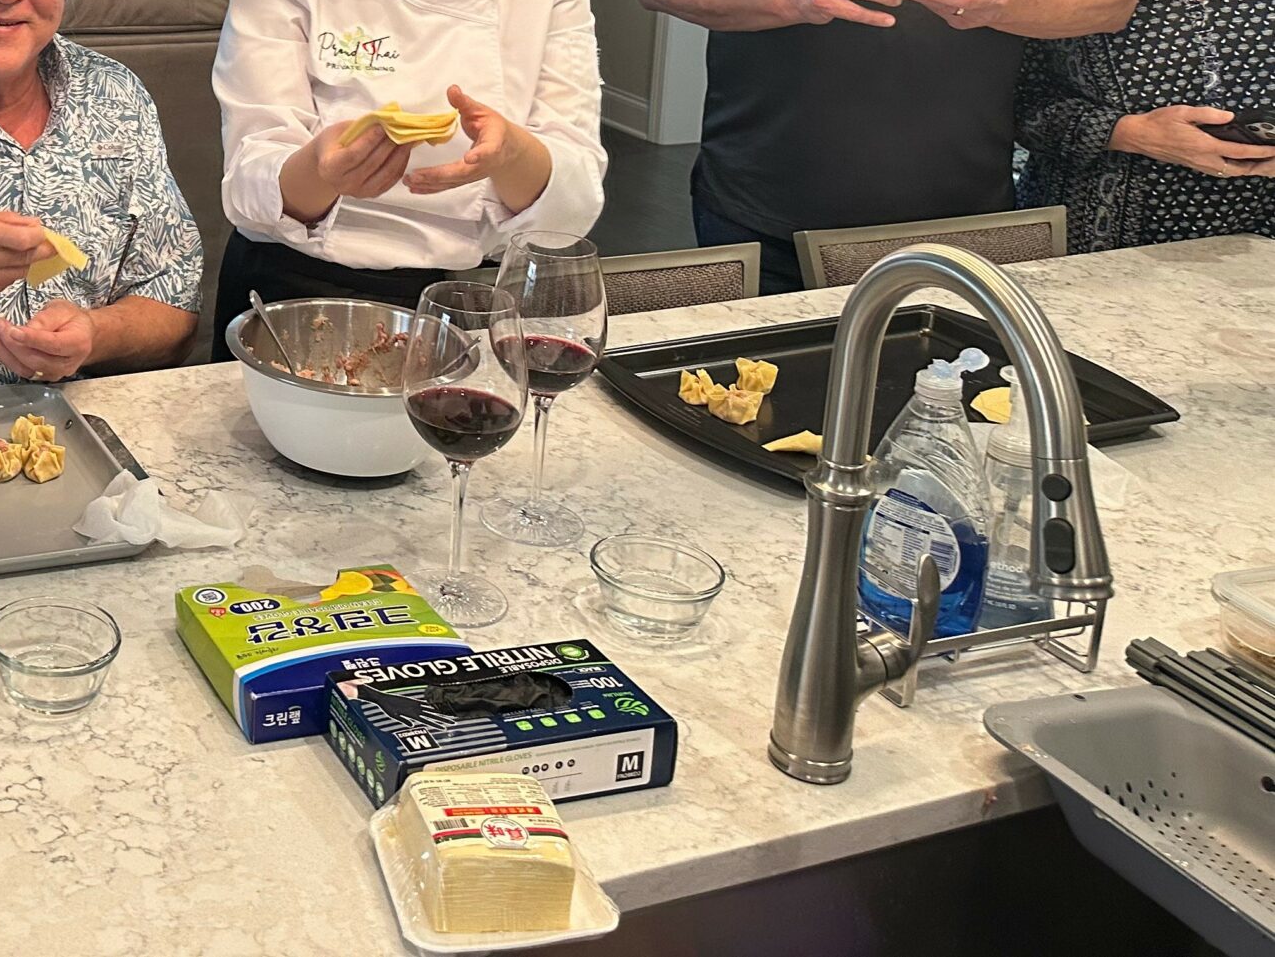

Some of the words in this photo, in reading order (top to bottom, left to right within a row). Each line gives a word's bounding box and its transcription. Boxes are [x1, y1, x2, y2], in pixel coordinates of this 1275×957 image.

[362, 35, 401, 67] Thai
[988, 560, 1023, 573] ethod
[247, 605, 420, 644] 크린장갑
[456, 645, 556, 672] NITRILE
[500, 657, 564, 674] DISPOSABLE
[353, 657, 458, 685] GLOVES
[591, 675, 624, 689] 100
[407, 734, 432, 750] M
[478, 757, 505, 767] NITRILE
[504, 752, 532, 762] GLOVES
[621, 755, 639, 772] M
